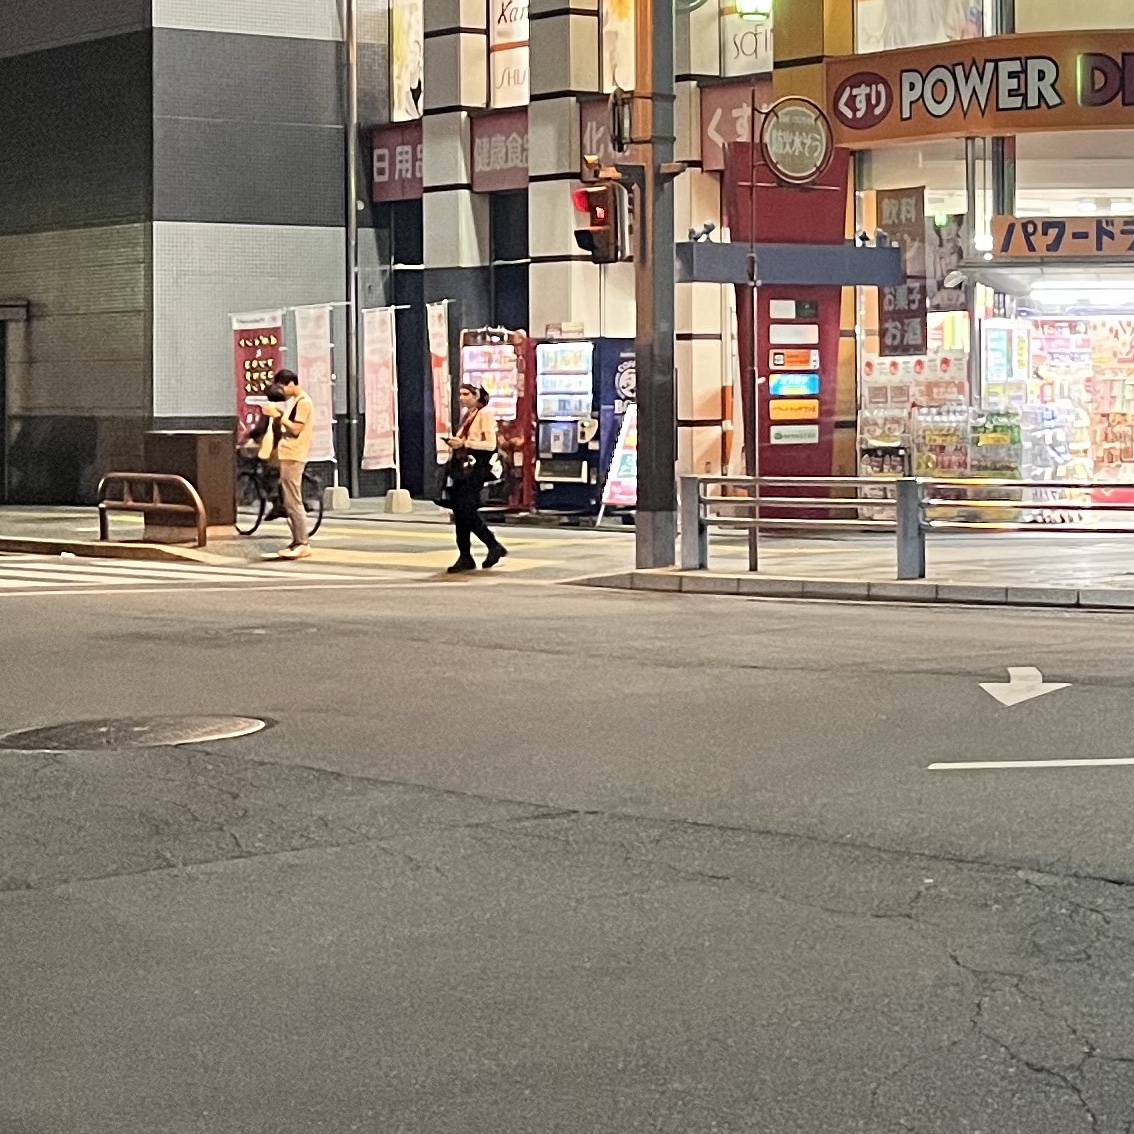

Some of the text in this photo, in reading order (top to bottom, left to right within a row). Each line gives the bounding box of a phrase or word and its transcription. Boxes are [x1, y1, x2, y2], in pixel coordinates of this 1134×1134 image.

[837, 83, 887, 119] くすり
[900, 56, 1066, 121] POWER
[707, 102, 773, 150] くす
